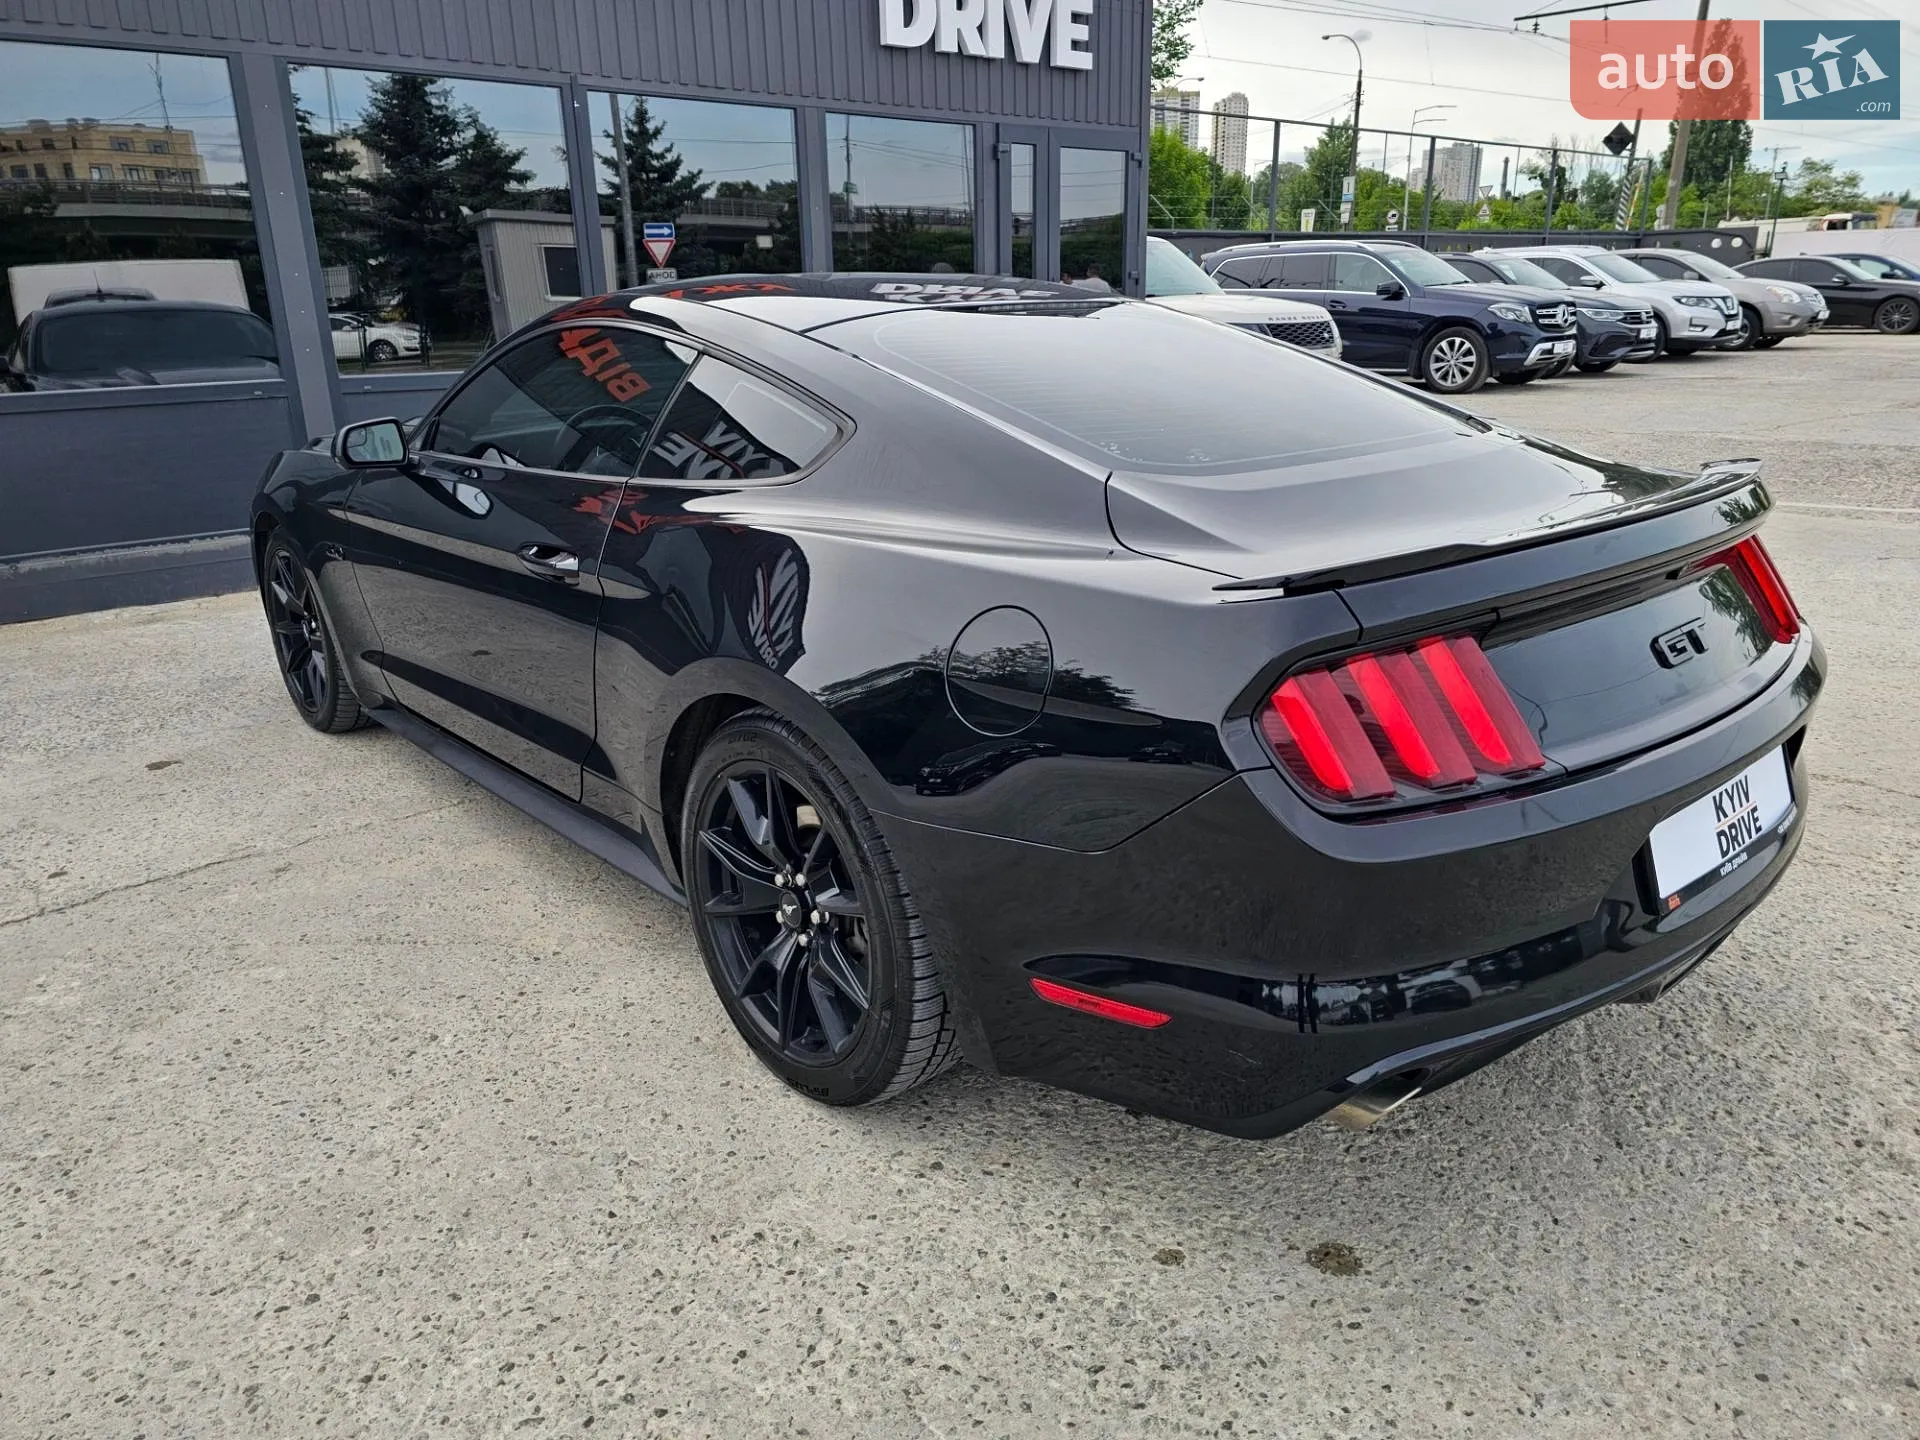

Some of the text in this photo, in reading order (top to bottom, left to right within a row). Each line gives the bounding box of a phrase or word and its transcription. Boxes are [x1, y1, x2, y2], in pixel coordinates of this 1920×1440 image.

[880, 0, 1093, 70] DRIVE
[1649, 616, 1709, 670] GT
[1712, 775, 1750, 823] KYIV
[1716, 805, 1762, 859] DRIVE
